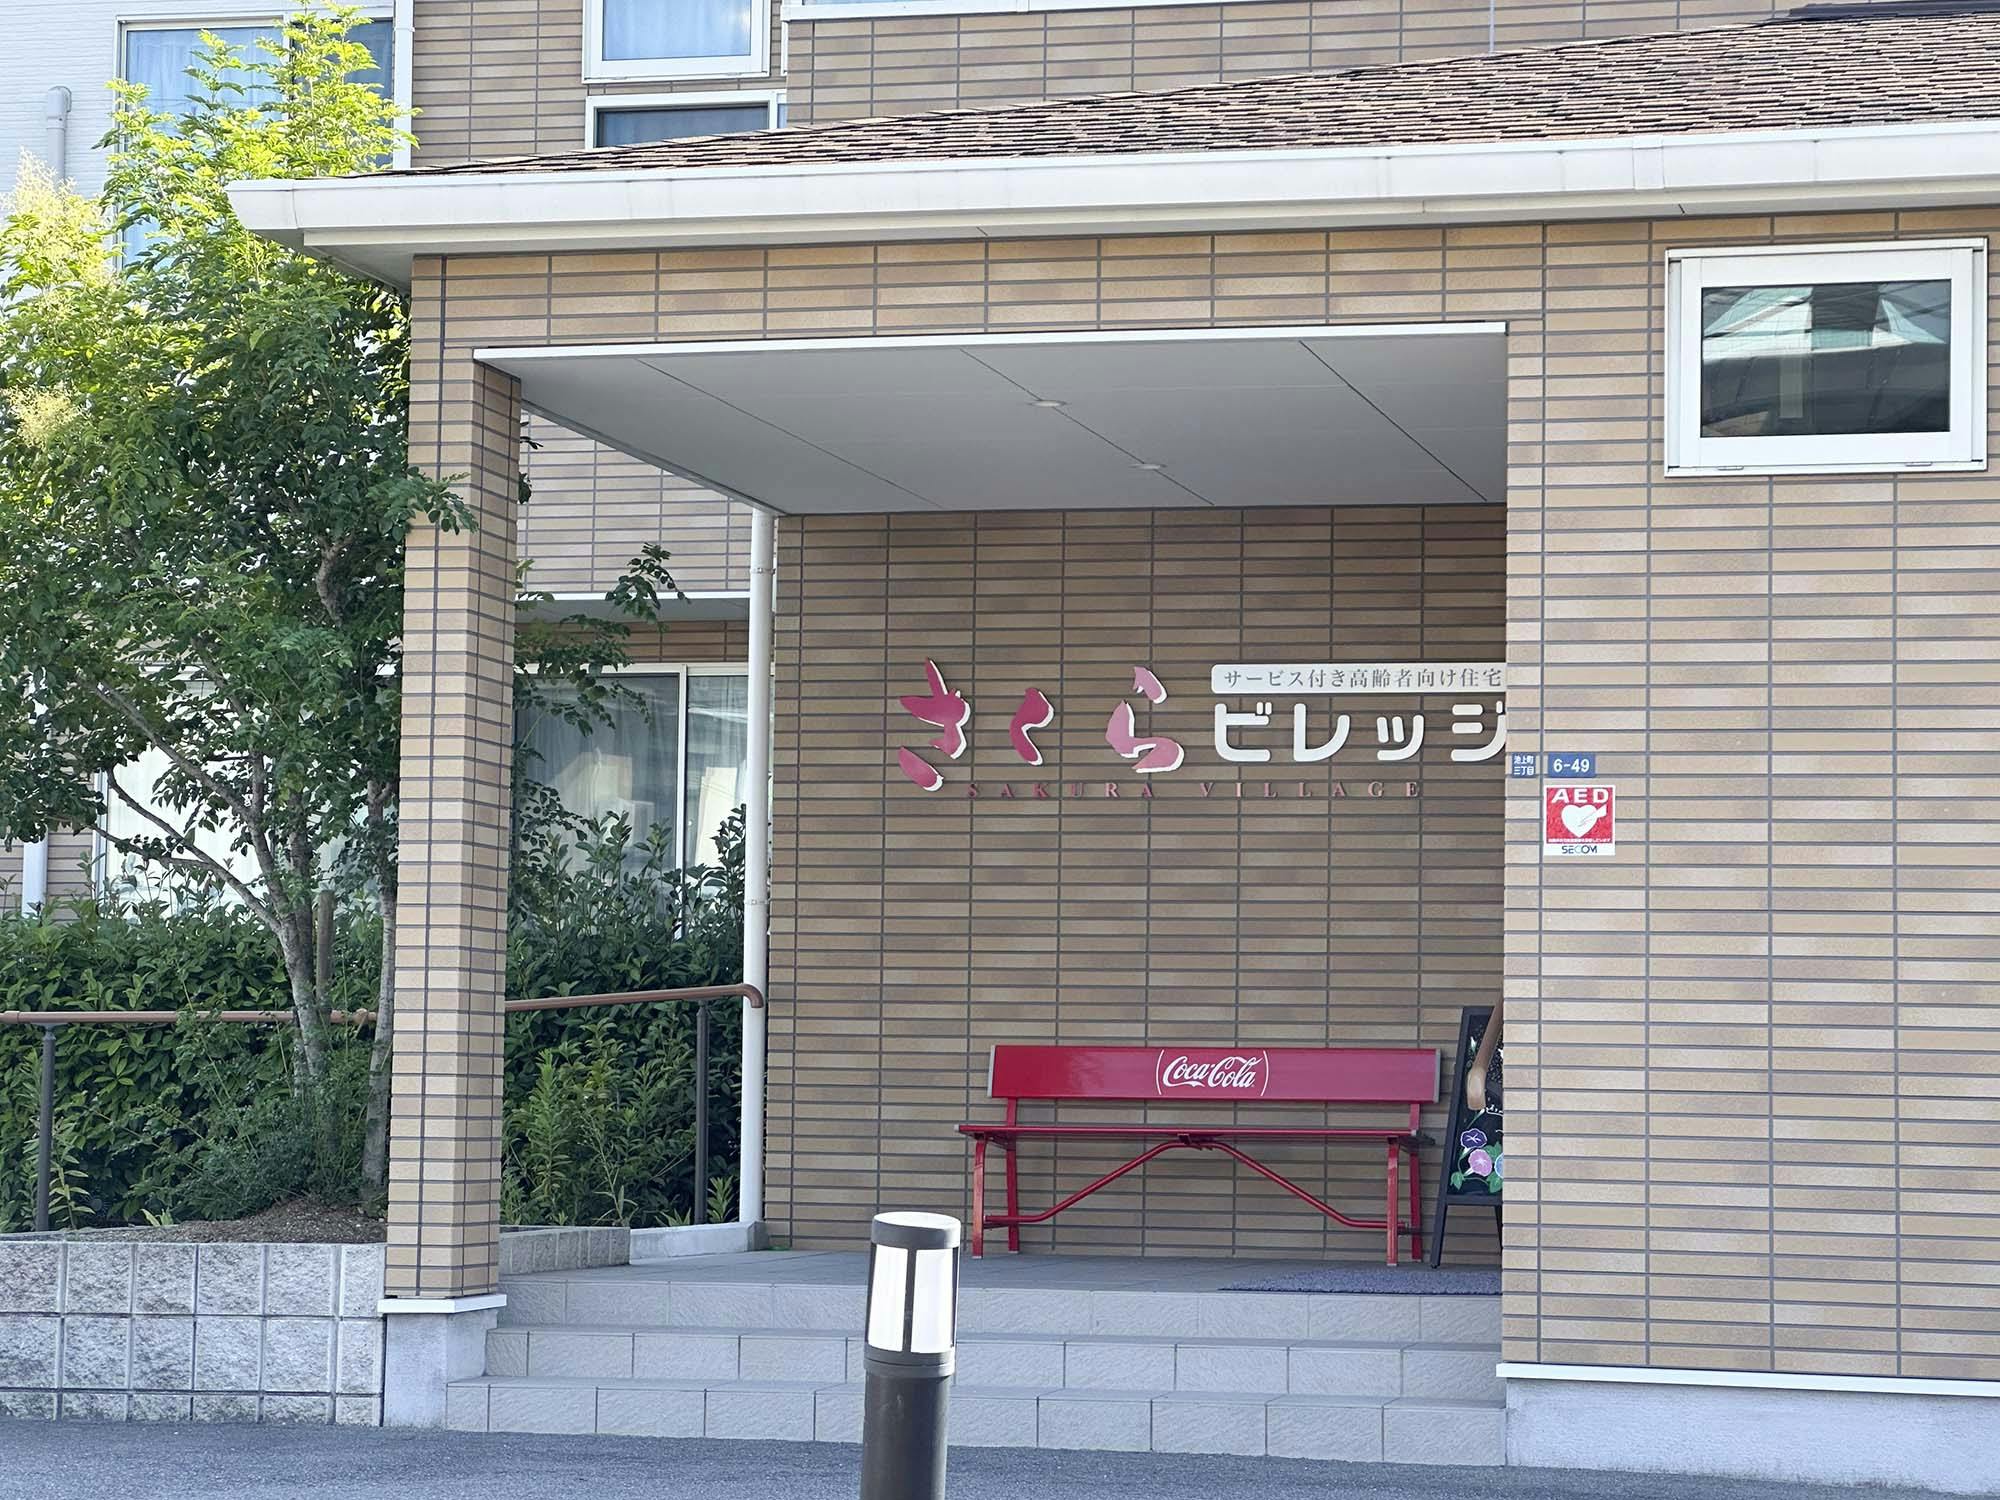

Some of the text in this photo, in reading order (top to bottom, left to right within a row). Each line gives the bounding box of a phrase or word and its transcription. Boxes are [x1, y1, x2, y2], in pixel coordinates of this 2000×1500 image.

[1224, 668, 1503, 689] サービス付き高齢者向け住宅
[899, 656, 1507, 792] さくら ビレッジ
[1513, 766, 1535, 776] 三丁目
[1553, 758, 1590, 773] 6-49
[967, 781, 1421, 799] SAKURA VILLAGE
[1551, 788, 1610, 804] AED
[1561, 845, 1598, 855] SECOM
[1162, 1055, 1264, 1088] Coca-Cola
